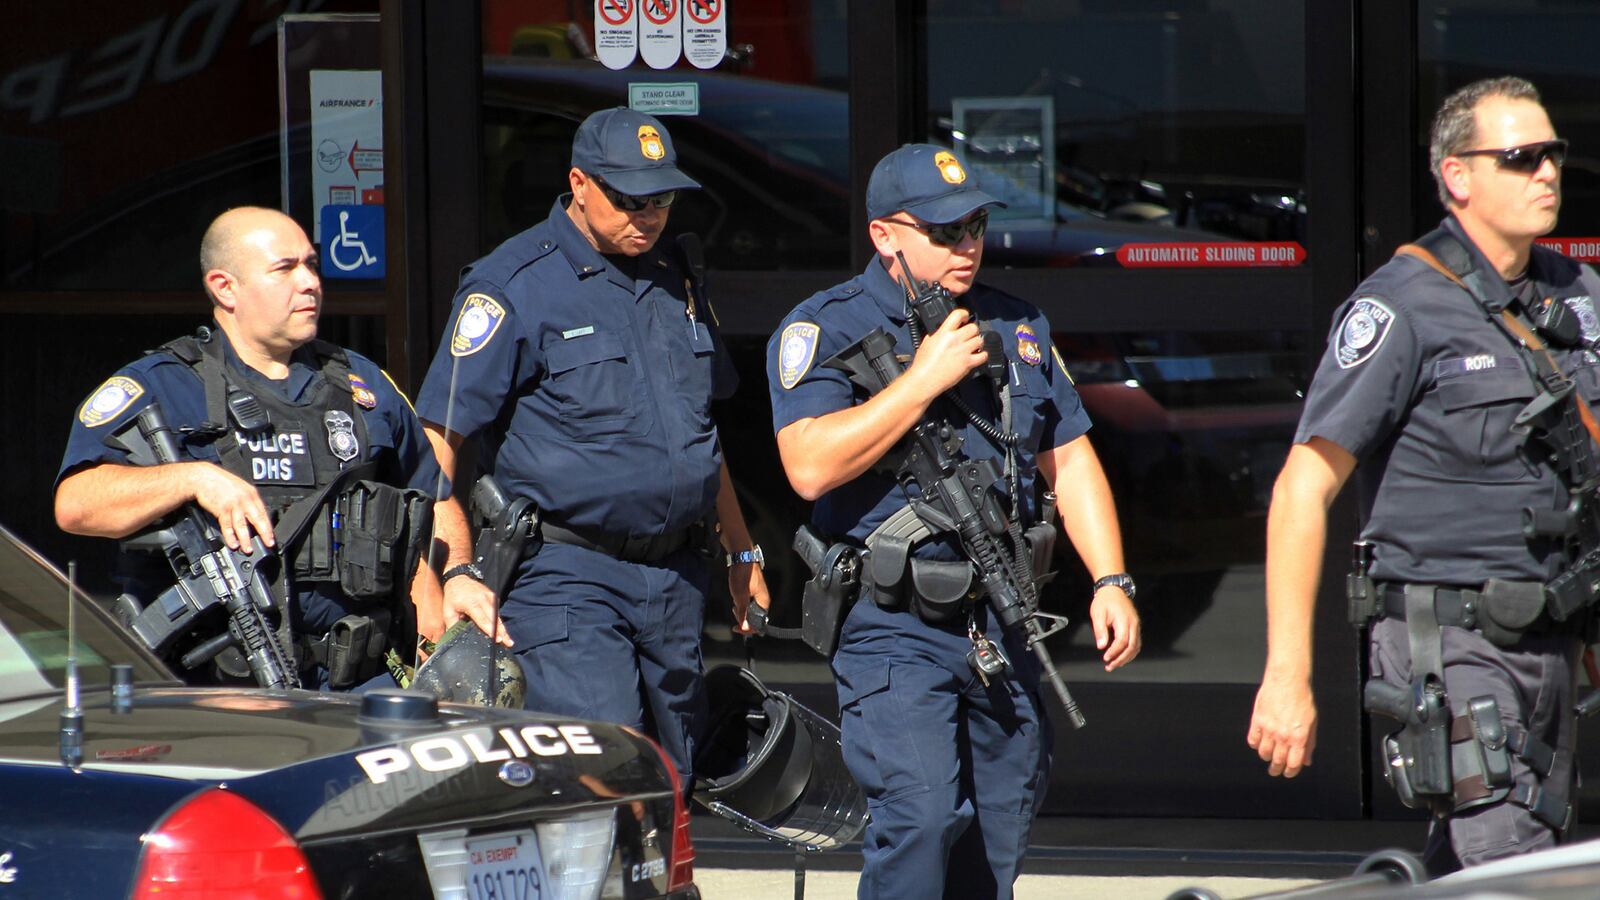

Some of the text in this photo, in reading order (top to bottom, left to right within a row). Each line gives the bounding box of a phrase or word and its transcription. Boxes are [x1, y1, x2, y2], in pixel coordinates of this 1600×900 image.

[665, 90, 685, 98] CLEAR
[319, 99, 367, 108] AIRFRANCE
[1127, 246, 1296, 263] AUTOMATIC SLIDING DOOR
[468, 297, 504, 319] POLICE
[1355, 302, 1389, 324] POLICE
[785, 327, 815, 340] POLICE
[1465, 354, 1496, 371] ROTH
[109, 379, 139, 396] POLICE
[234, 431, 305, 455] POLICE
[251, 457, 293, 481] DHS
[355, 724, 603, 785] POLICE
[470, 846, 518, 865] CA EXEMPT
[632, 864, 640, 882] C
